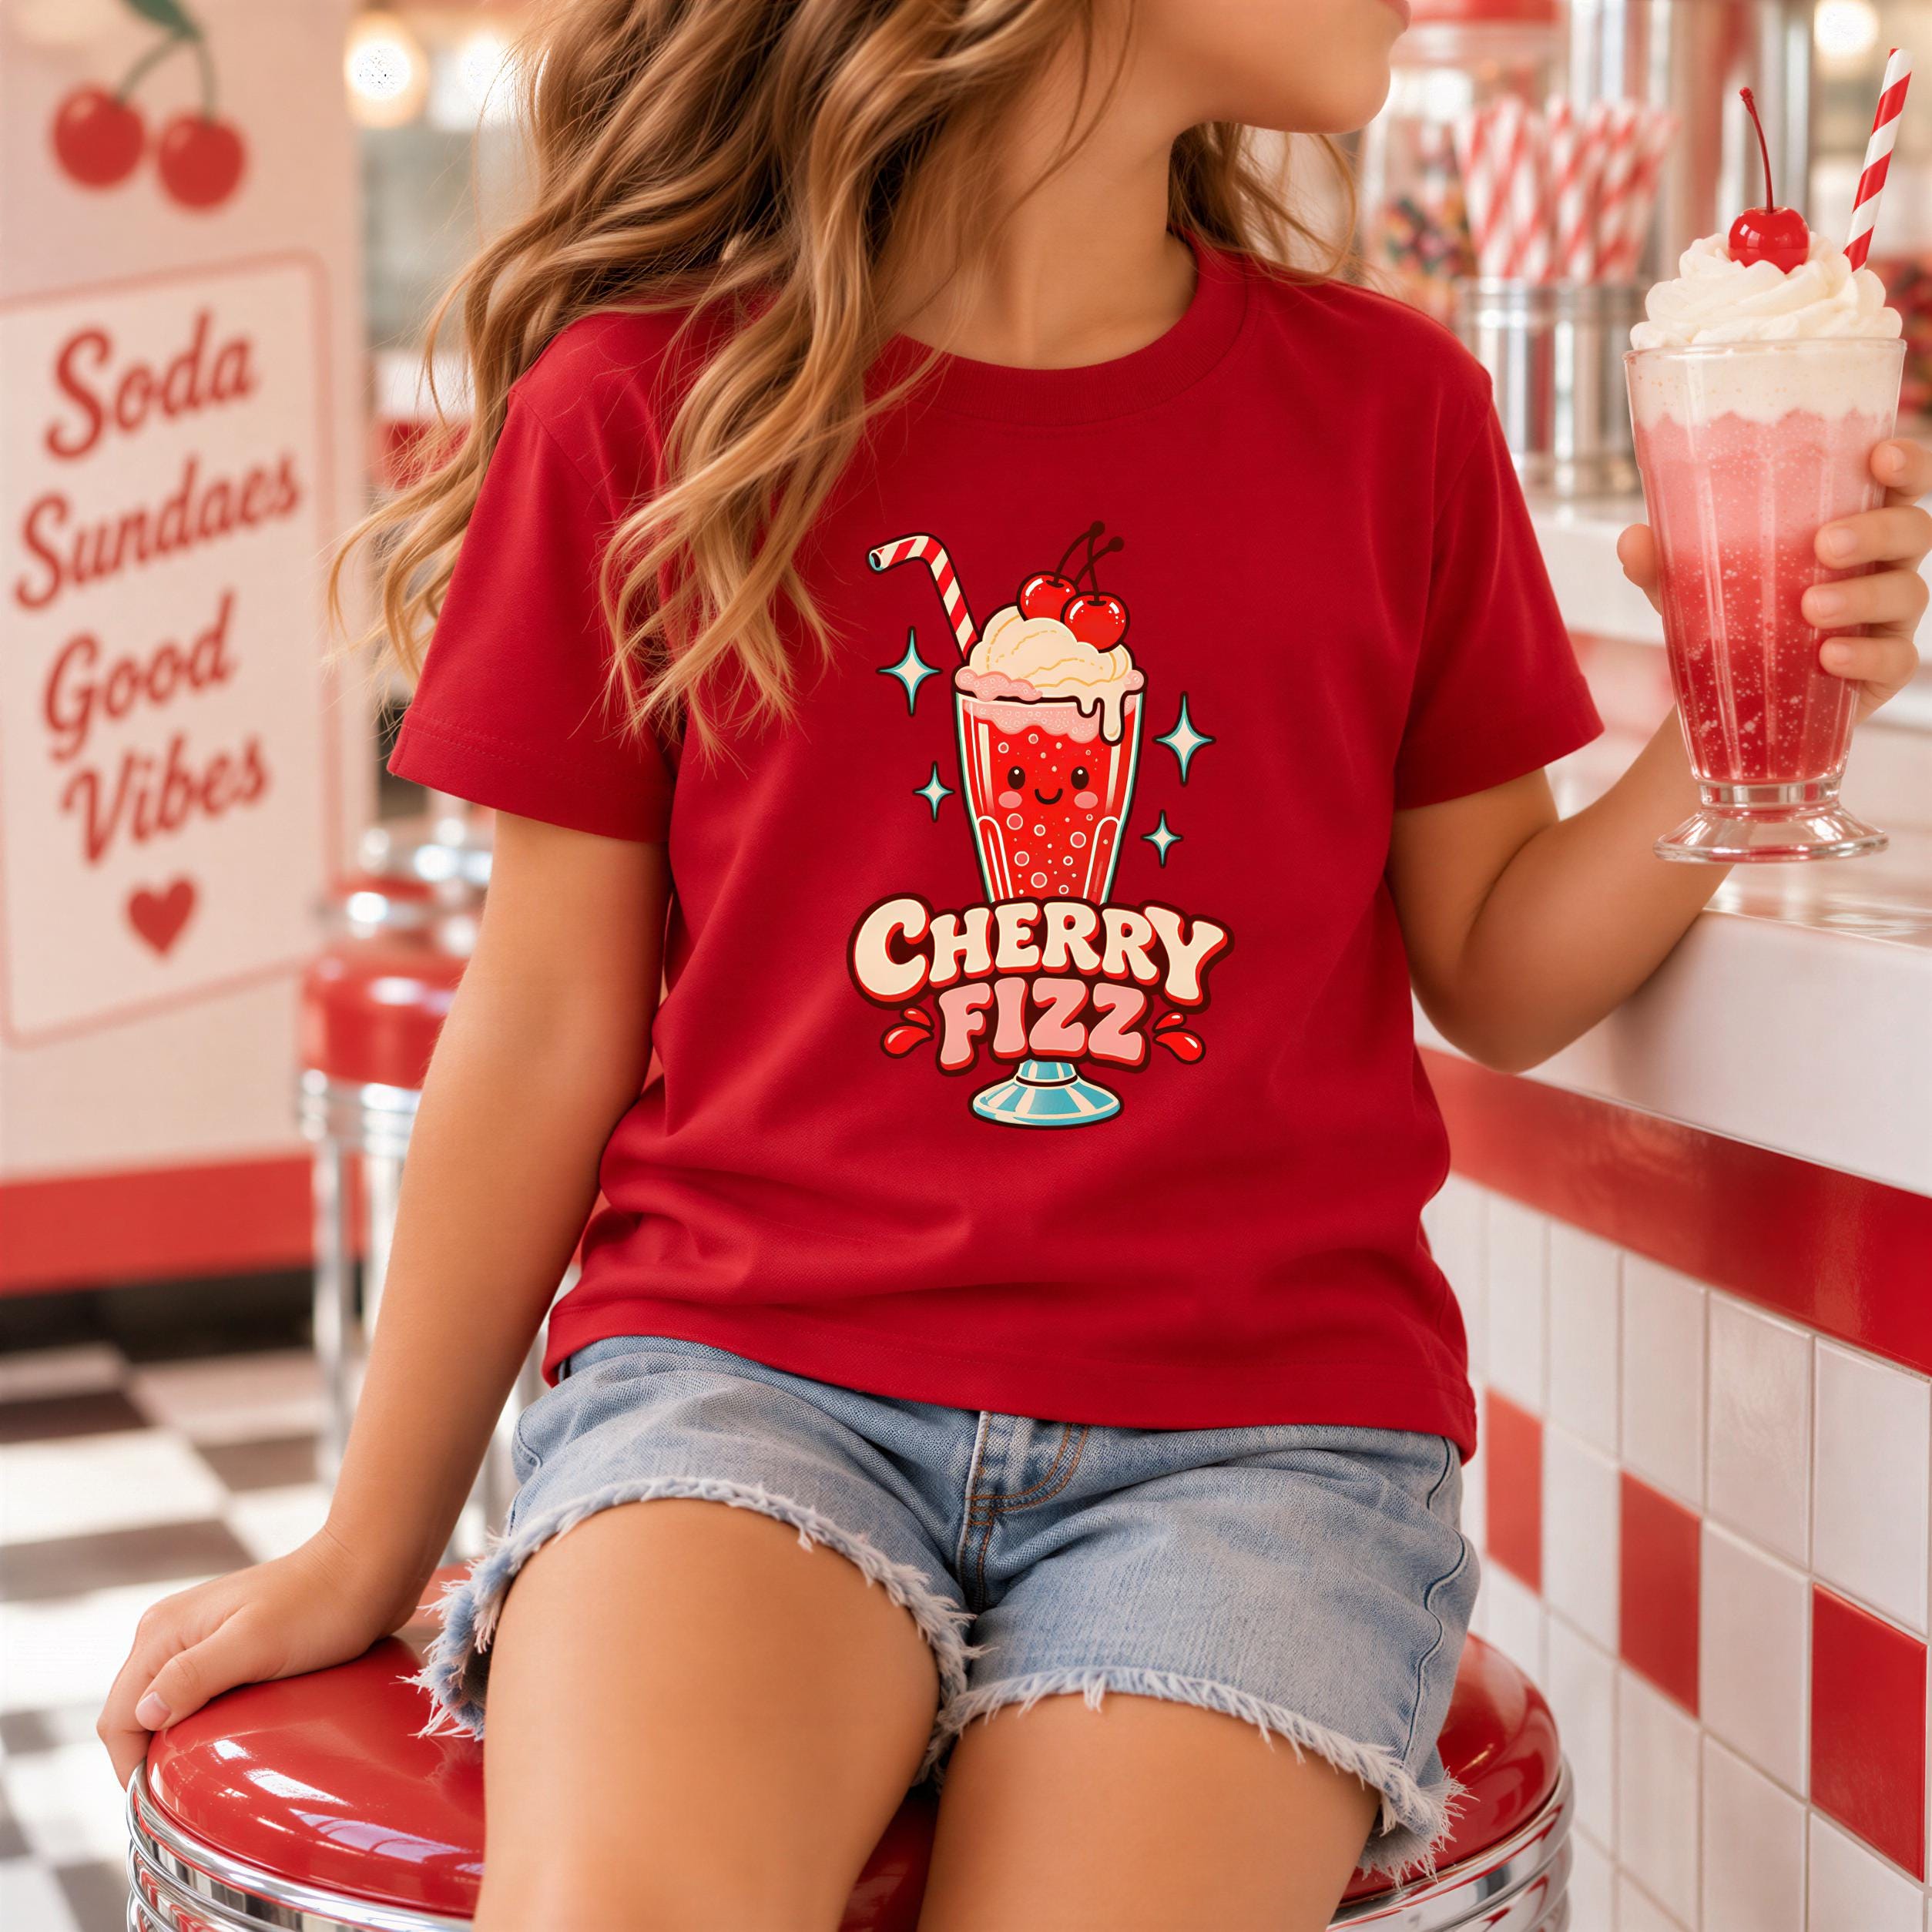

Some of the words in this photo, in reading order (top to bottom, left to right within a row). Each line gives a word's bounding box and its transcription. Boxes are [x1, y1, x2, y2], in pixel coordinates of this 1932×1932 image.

[43, 308, 259, 461] Soda
[14, 453, 299, 610] Sundaes
[43, 589, 237, 763] Good
[62, 732, 270, 867] Vibes
[852, 897, 1228, 1006] CHERRY
[937, 976, 1148, 1070] FIZZ
